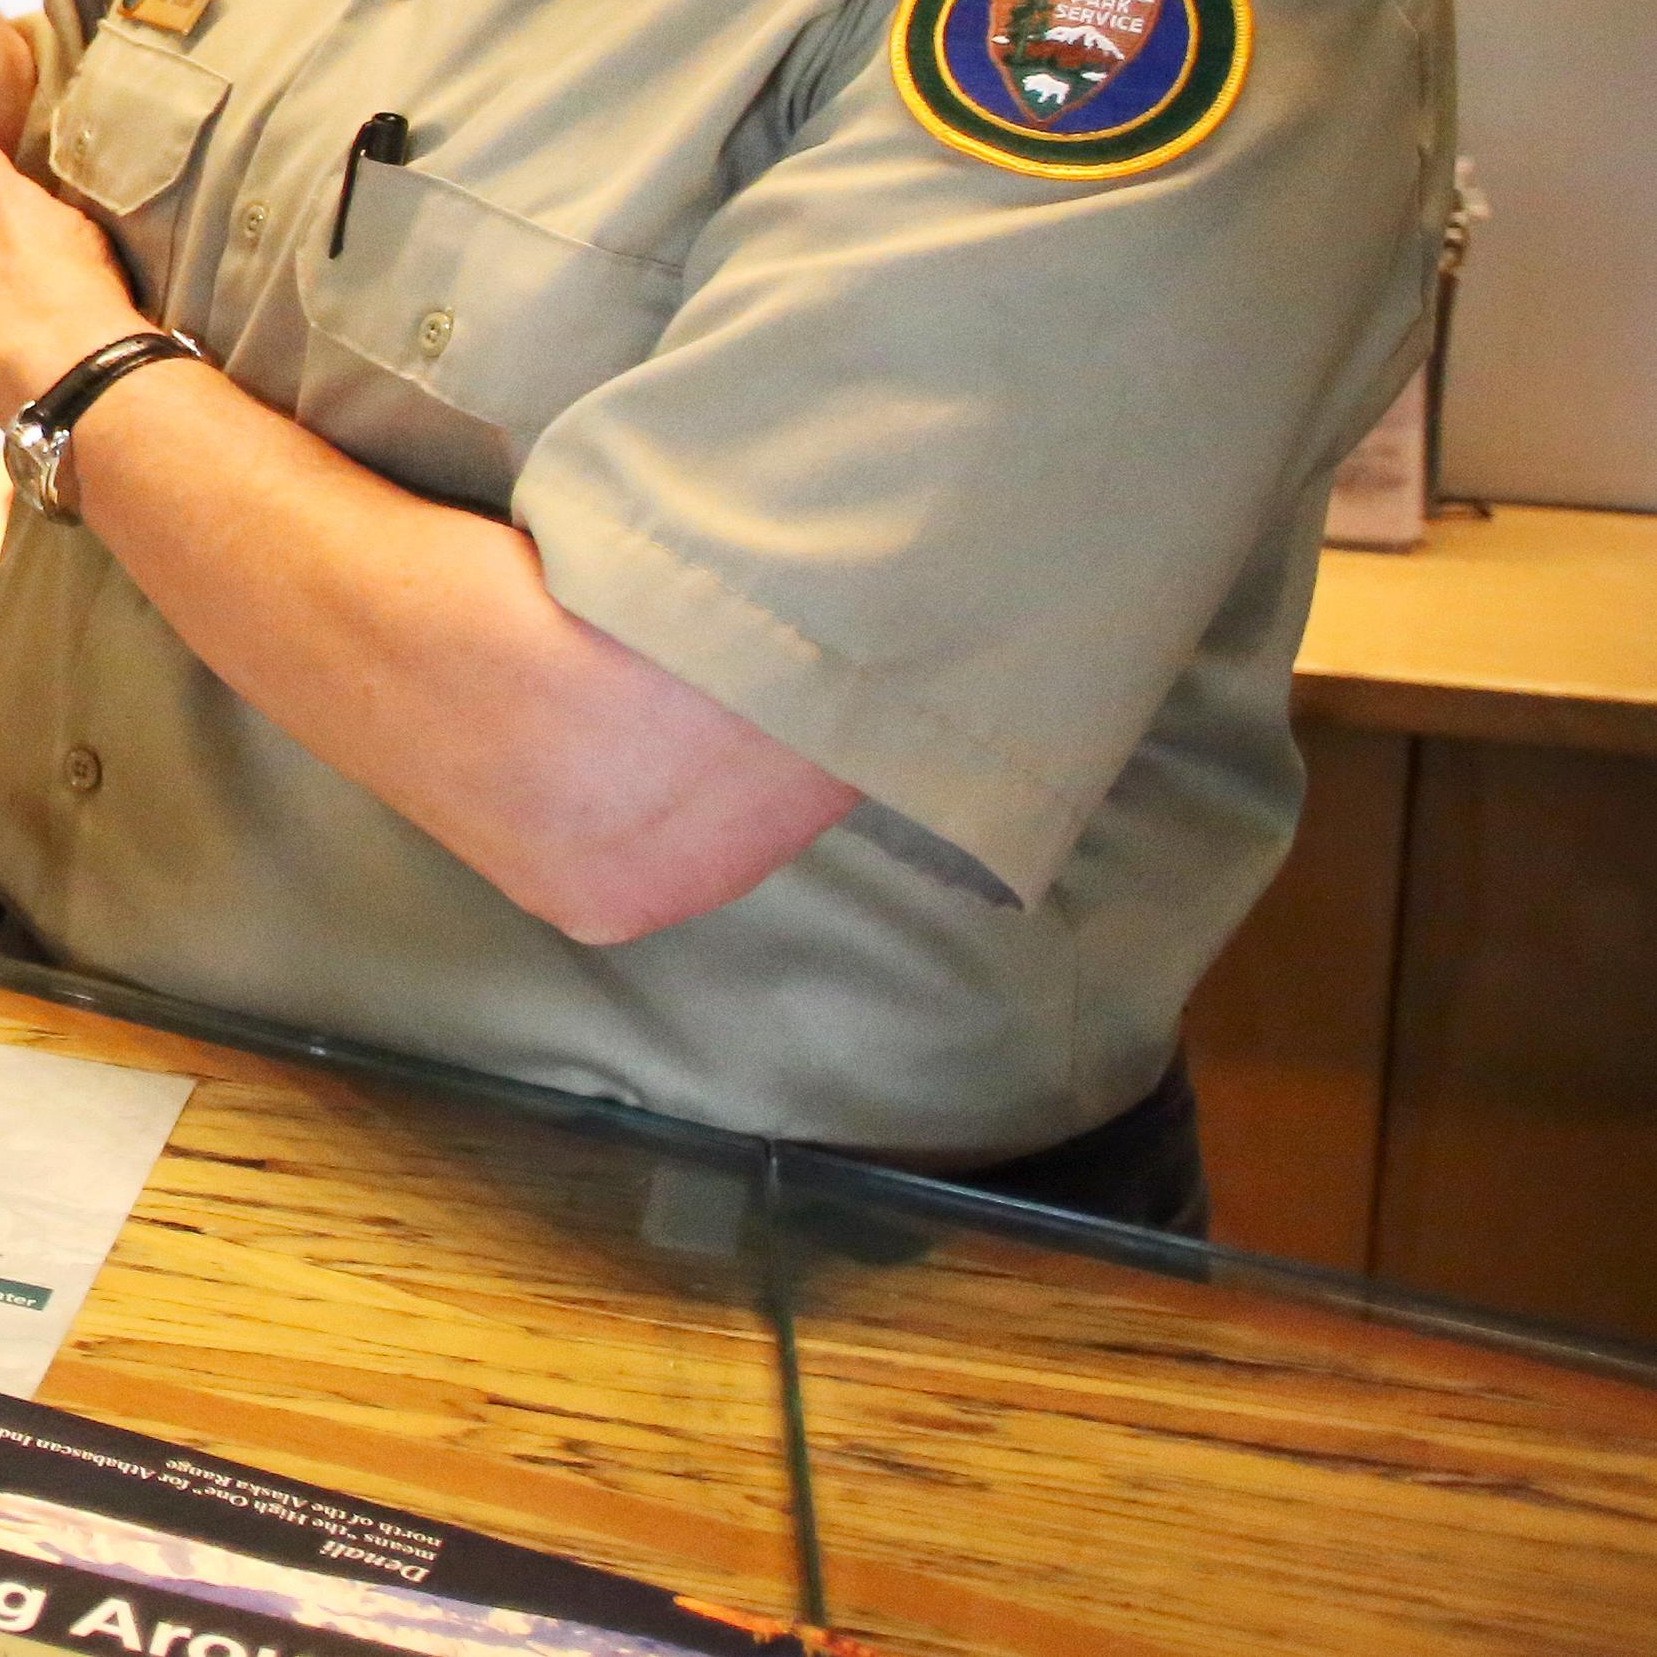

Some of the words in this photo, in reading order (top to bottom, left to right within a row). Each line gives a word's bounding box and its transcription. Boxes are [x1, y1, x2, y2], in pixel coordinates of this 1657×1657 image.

[1054, 3, 1144, 34] SERVICE
[36, 1437, 157, 1481] Athabascan
[165, 1458, 232, 1489] Range
[158, 1472, 192, 1492] for
[236, 1479, 308, 1510] Alaska
[253, 1498, 308, 1527] High
[312, 1503, 346, 1521] the
[347, 1512, 374, 1527] of
[363, 1532, 438, 1562] means
[377, 1521, 443, 1548] north
[319, 1540, 431, 1584] Denali
[69, 1596, 279, 1657] Aro
